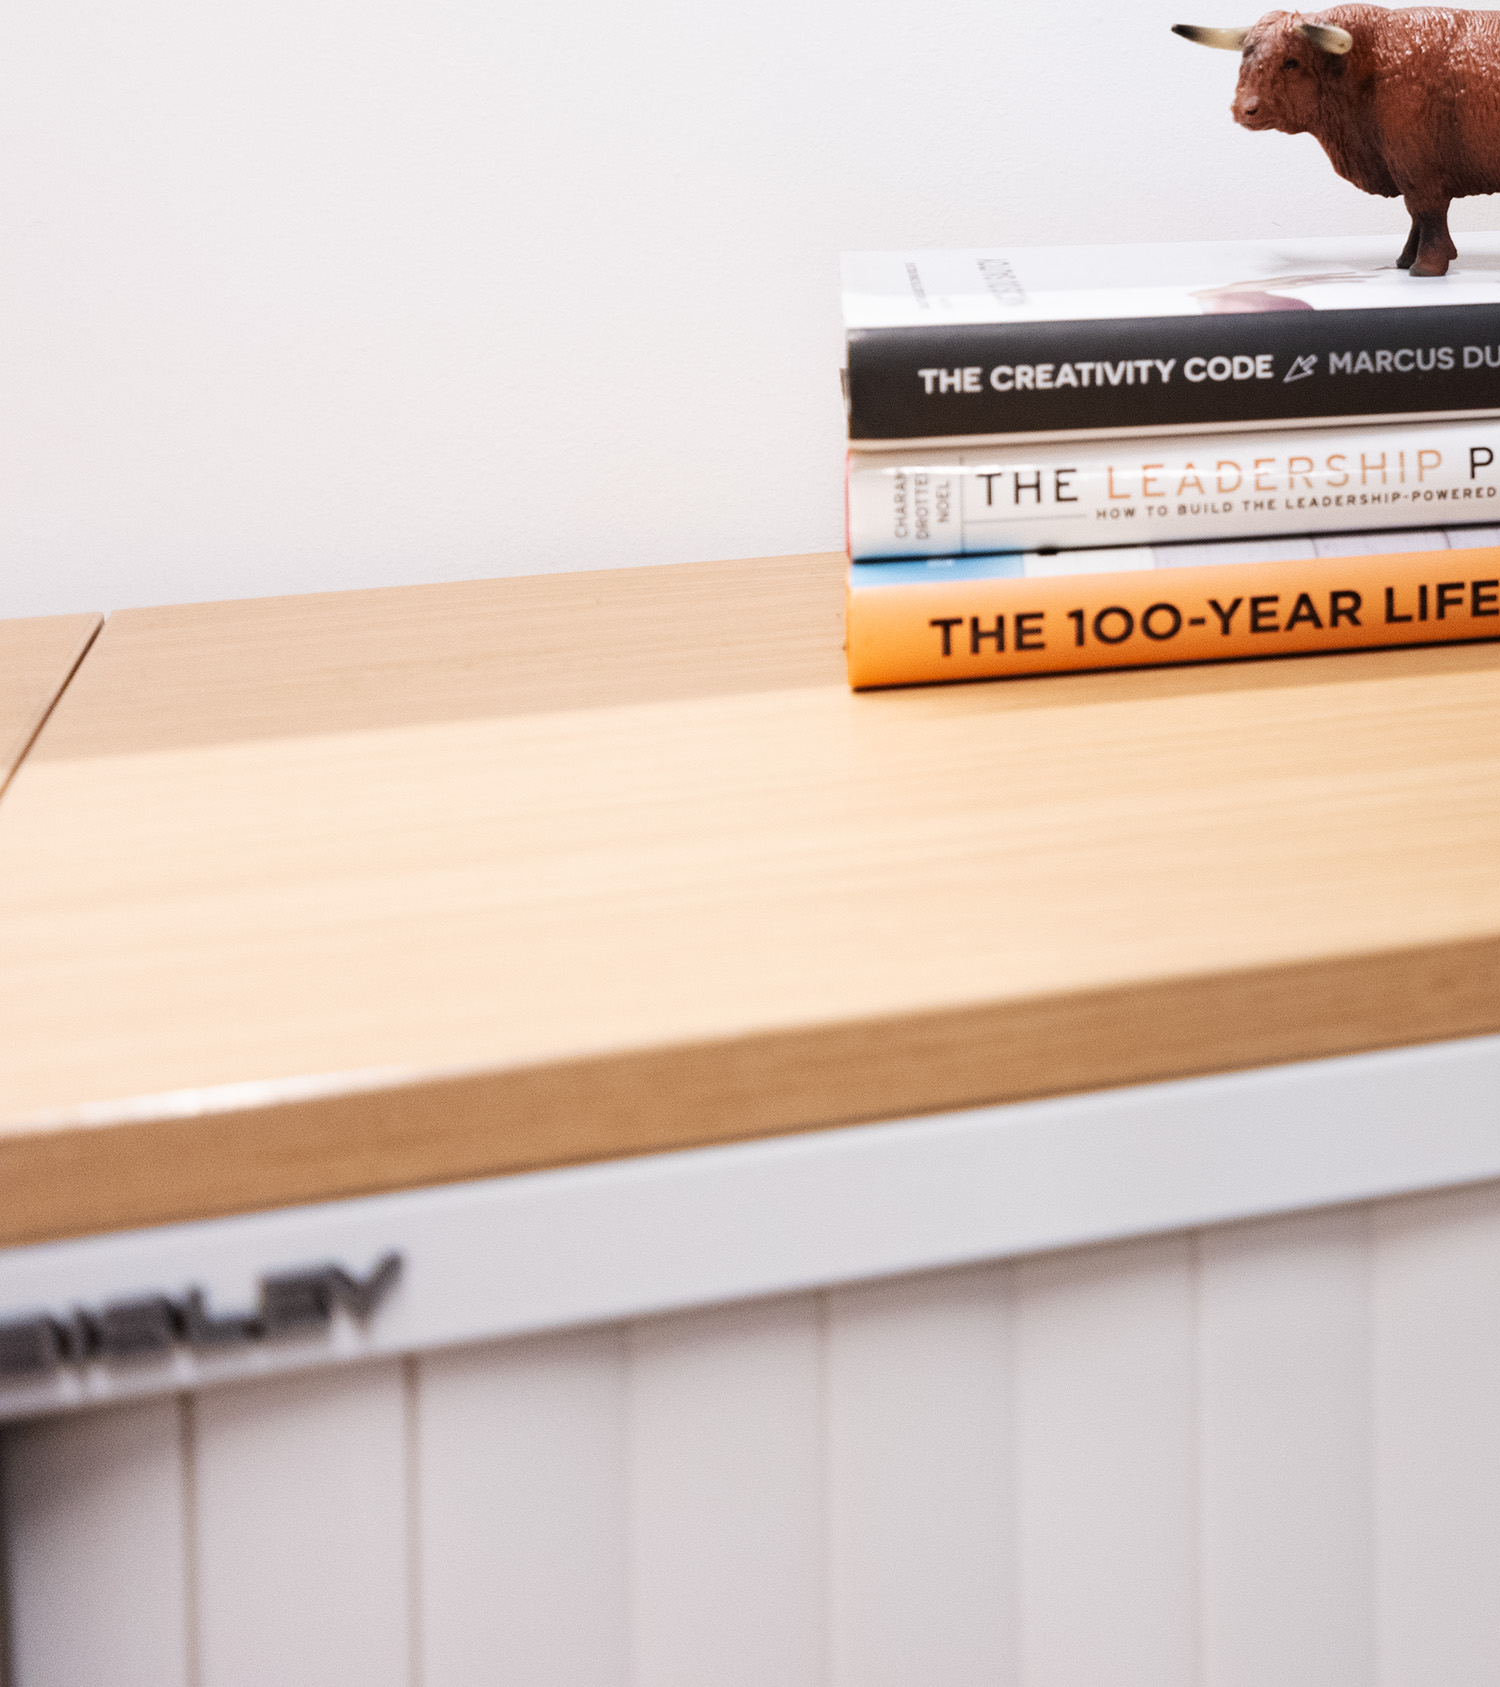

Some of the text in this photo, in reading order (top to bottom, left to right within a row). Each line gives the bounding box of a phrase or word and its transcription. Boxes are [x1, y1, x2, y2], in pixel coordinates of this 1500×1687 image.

[918, 354, 1274, 394] THE CREATIVITY CODE
[1328, 346, 1455, 375] MARCUS
[976, 468, 1079, 506] THE
[1108, 448, 1443, 500] LEADERSHIP
[1096, 506, 1136, 520] HOW
[1147, 505, 1169, 518] TO
[1177, 501, 1234, 517] BUILD
[1243, 498, 1277, 512] THE
[1285, 485, 1498, 511] LEADERSHIP-POWERED
[930, 579, 1500, 657] THE 100-YEAR LIFE
